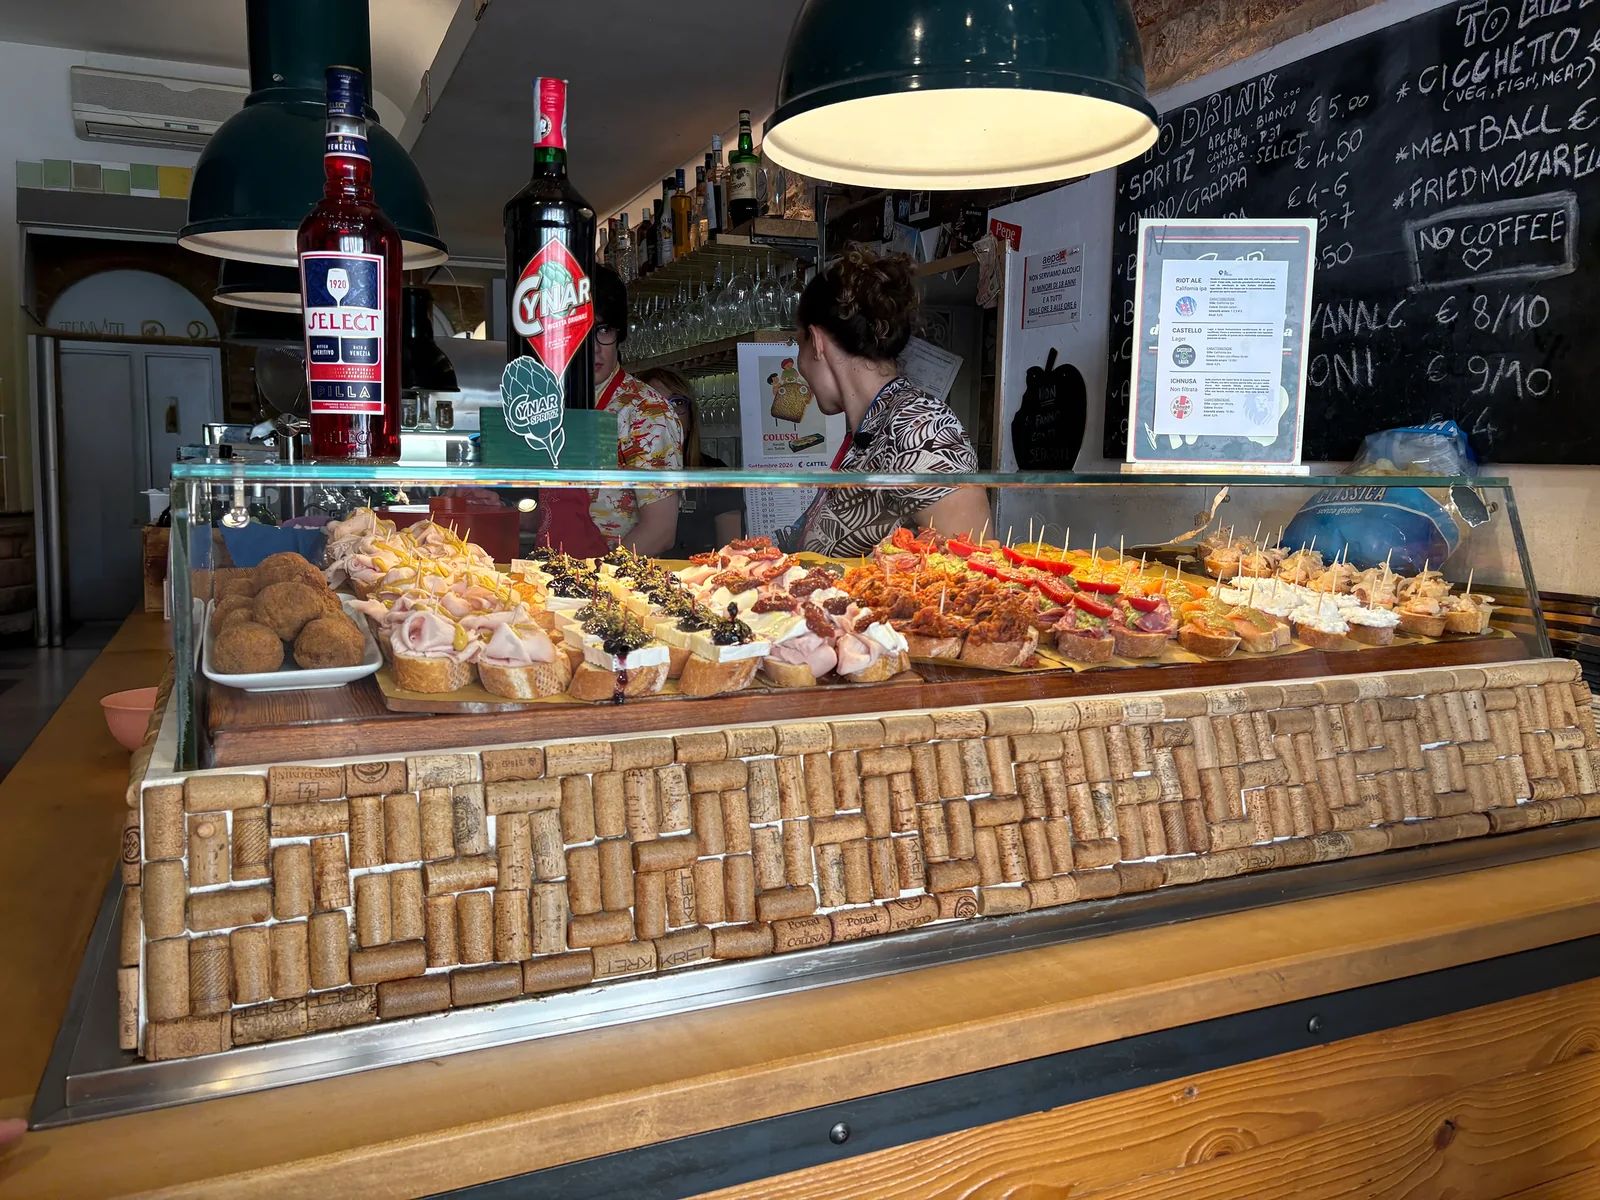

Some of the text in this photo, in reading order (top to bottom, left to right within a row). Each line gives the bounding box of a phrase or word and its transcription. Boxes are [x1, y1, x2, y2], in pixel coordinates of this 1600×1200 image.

[1456, 0, 1510, 47] TO
[1418, 27, 1581, 94] CICCHETTO
[1208, 124, 1243, 150] APEROL
[1256, 100, 1297, 130] BIANCO
[1412, 104, 1562, 160] MEATBALL
[1207, 134, 1248, 164] CAMPARI
[1129, 148, 1195, 200] SPRITZ
[1209, 153, 1245, 175] CYNAR
[1255, 130, 1309, 165] SELECT
[1409, 166, 1477, 208] FRIED
[996, 222, 1016, 241] Pepe
[1419, 209, 1566, 250] NO COFFEE
[1028, 273, 1039, 282] NON
[1038, 269, 1061, 280] SERVIAMO
[1061, 265, 1081, 275] ALCOLICI
[330, 280, 347, 288] 1920
[1037, 282, 1053, 292] MINORI
[1053, 281, 1058, 290] DI
[1059, 280, 1064, 288] 18
[1064, 278, 1076, 287] ANNI
[512, 274, 591, 337] CYNAR
[1050, 294, 1062, 302] TUTTI
[1028, 307, 1041, 316] DALLE
[1041, 305, 1050, 314] ORE
[1053, 303, 1064, 311] ALLE
[1064, 302, 1073, 310] ORE
[1435, 295, 1459, 324] €
[1472, 294, 1550, 334] 8/10
[308, 312, 379, 331] SELECT
[548, 312, 587, 330] RICETTA ORIGINALE
[1468, 355, 1552, 399] 9/10
[318, 386, 370, 398] PILLA
[1039, 385, 1057, 399] NON
[509, 394, 557, 427] CYNAR
[530, 409, 559, 425] SPRITZ
[763, 433, 799, 441] COLUSSI
[1317, 487, 1387, 503] CLASSICA
[1317, 507, 1363, 516] senza glutine
[680, 870, 695, 923] KRET
[787, 917, 821, 930] PODERI
[847, 913, 878, 927] PODERI
[787, 934, 826, 947] COLLINA
[602, 955, 654, 975] KRET
[660, 944, 709, 969] KRET
